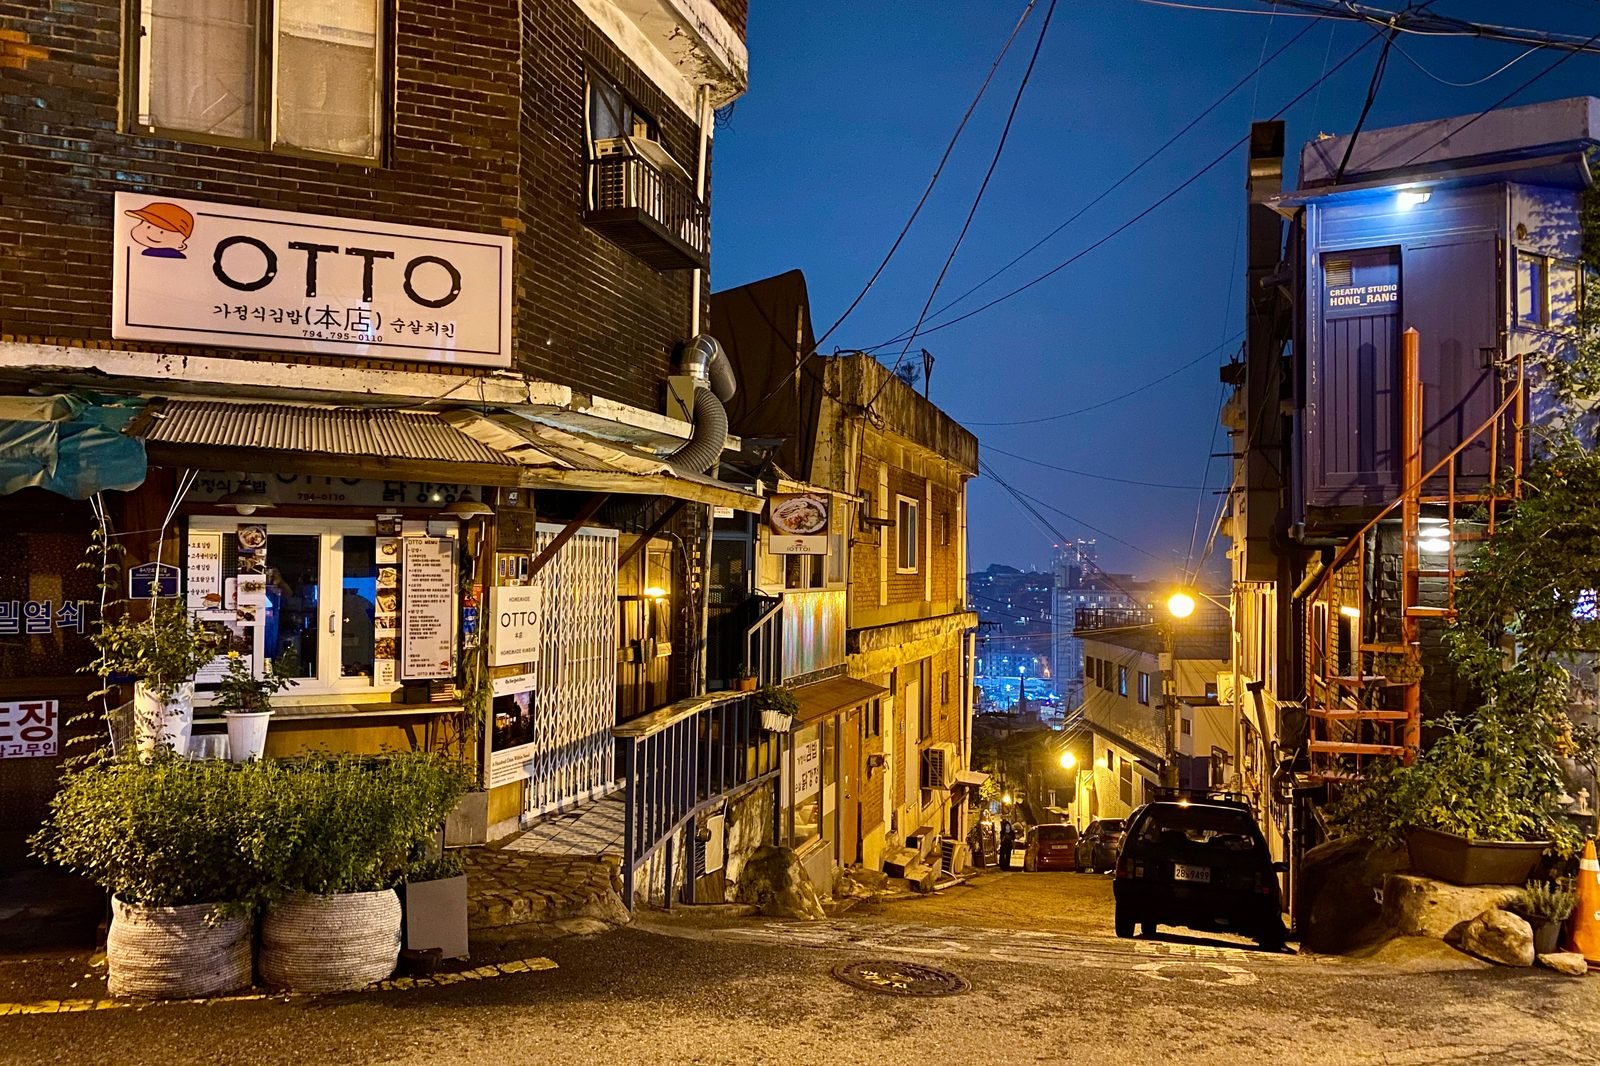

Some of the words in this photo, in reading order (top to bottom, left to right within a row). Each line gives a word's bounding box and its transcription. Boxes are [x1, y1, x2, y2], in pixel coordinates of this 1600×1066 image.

[212, 236, 462, 308] OTTO
[1330, 287, 1366, 296] CREATIVE
[1367, 284, 1397, 293] STUDIO
[1330, 293, 1397, 306] HONG_RANG
[390, 318, 455, 338] 순살치킨
[500, 611, 537, 628] OTTO
